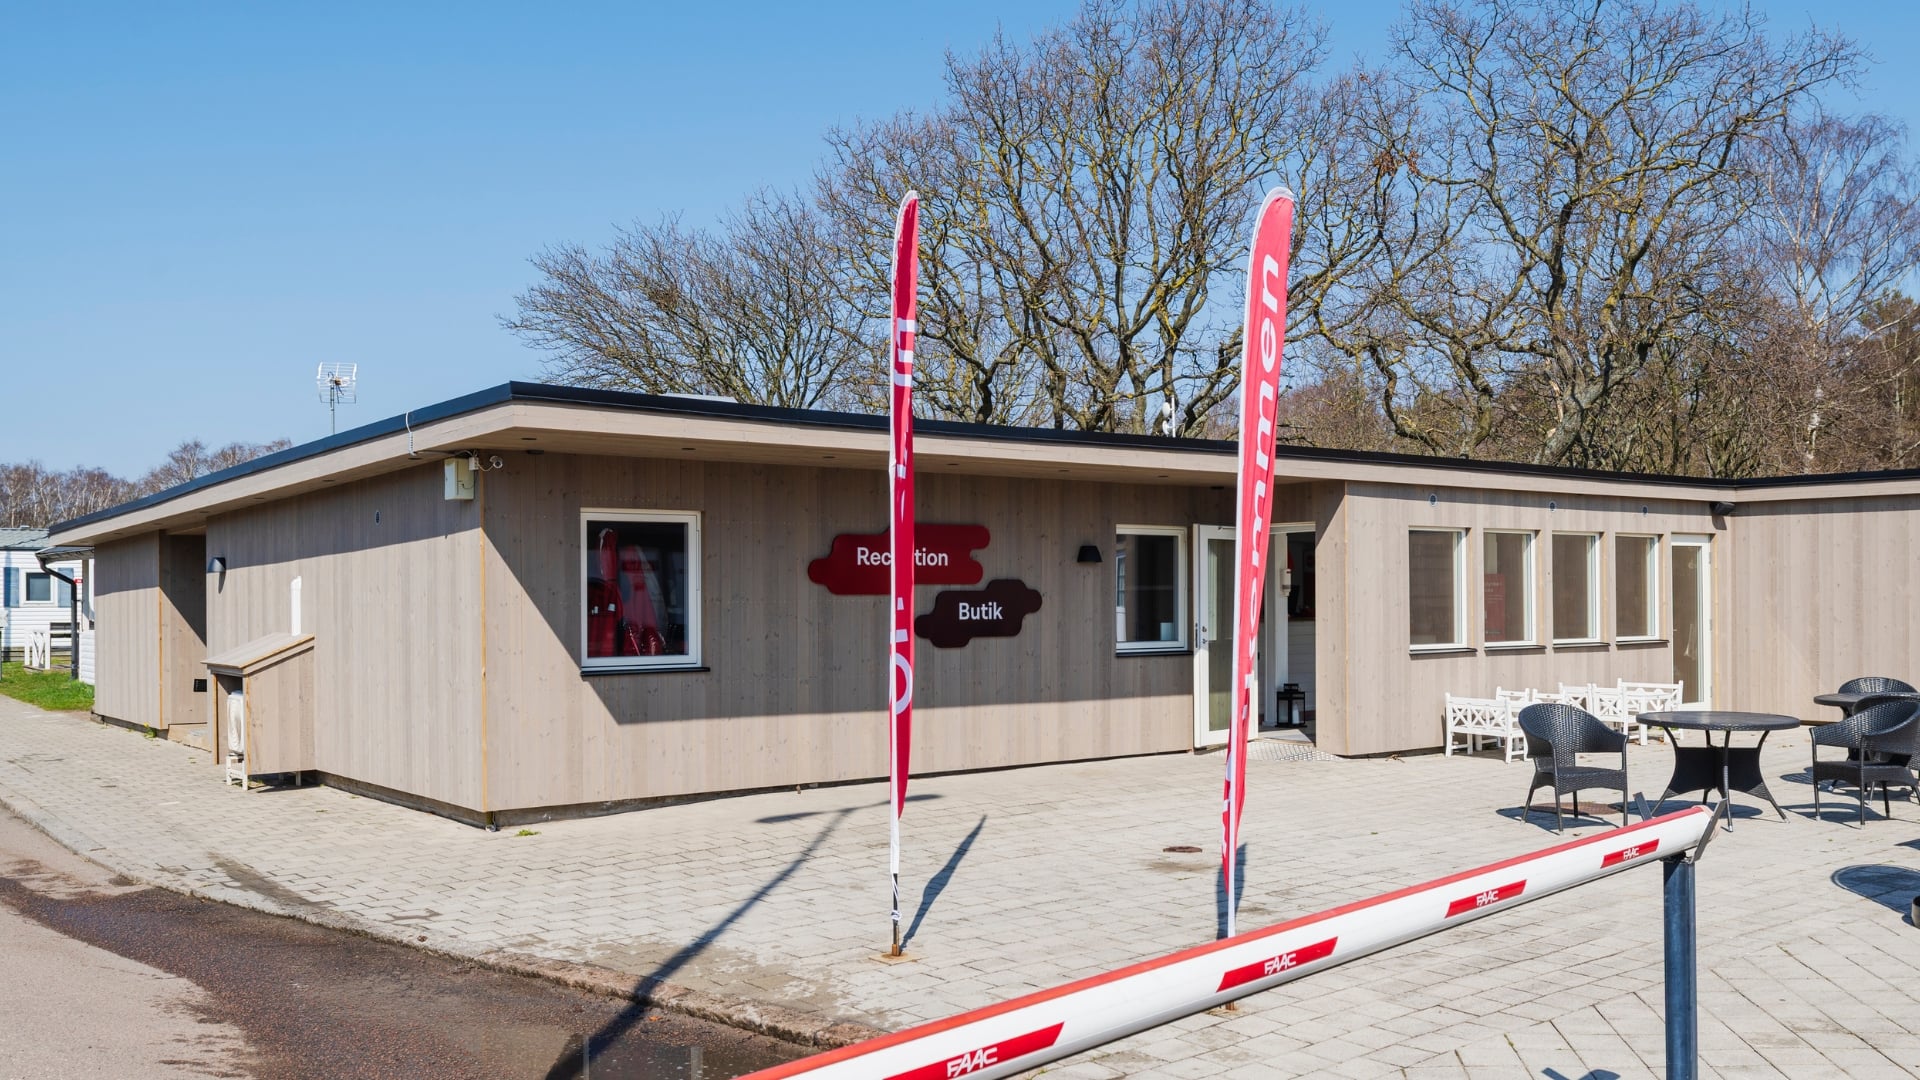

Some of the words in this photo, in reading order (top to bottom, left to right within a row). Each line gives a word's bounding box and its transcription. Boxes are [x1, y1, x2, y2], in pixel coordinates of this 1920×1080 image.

[857, 547, 948, 566] Rection
[959, 602, 1003, 620] Butik
[1623, 847, 1640, 860] FAAC
[1476, 890, 1499, 906] FAAC
[1264, 953, 1296, 975] FAAC
[946, 1047, 998, 1078] FAAC
